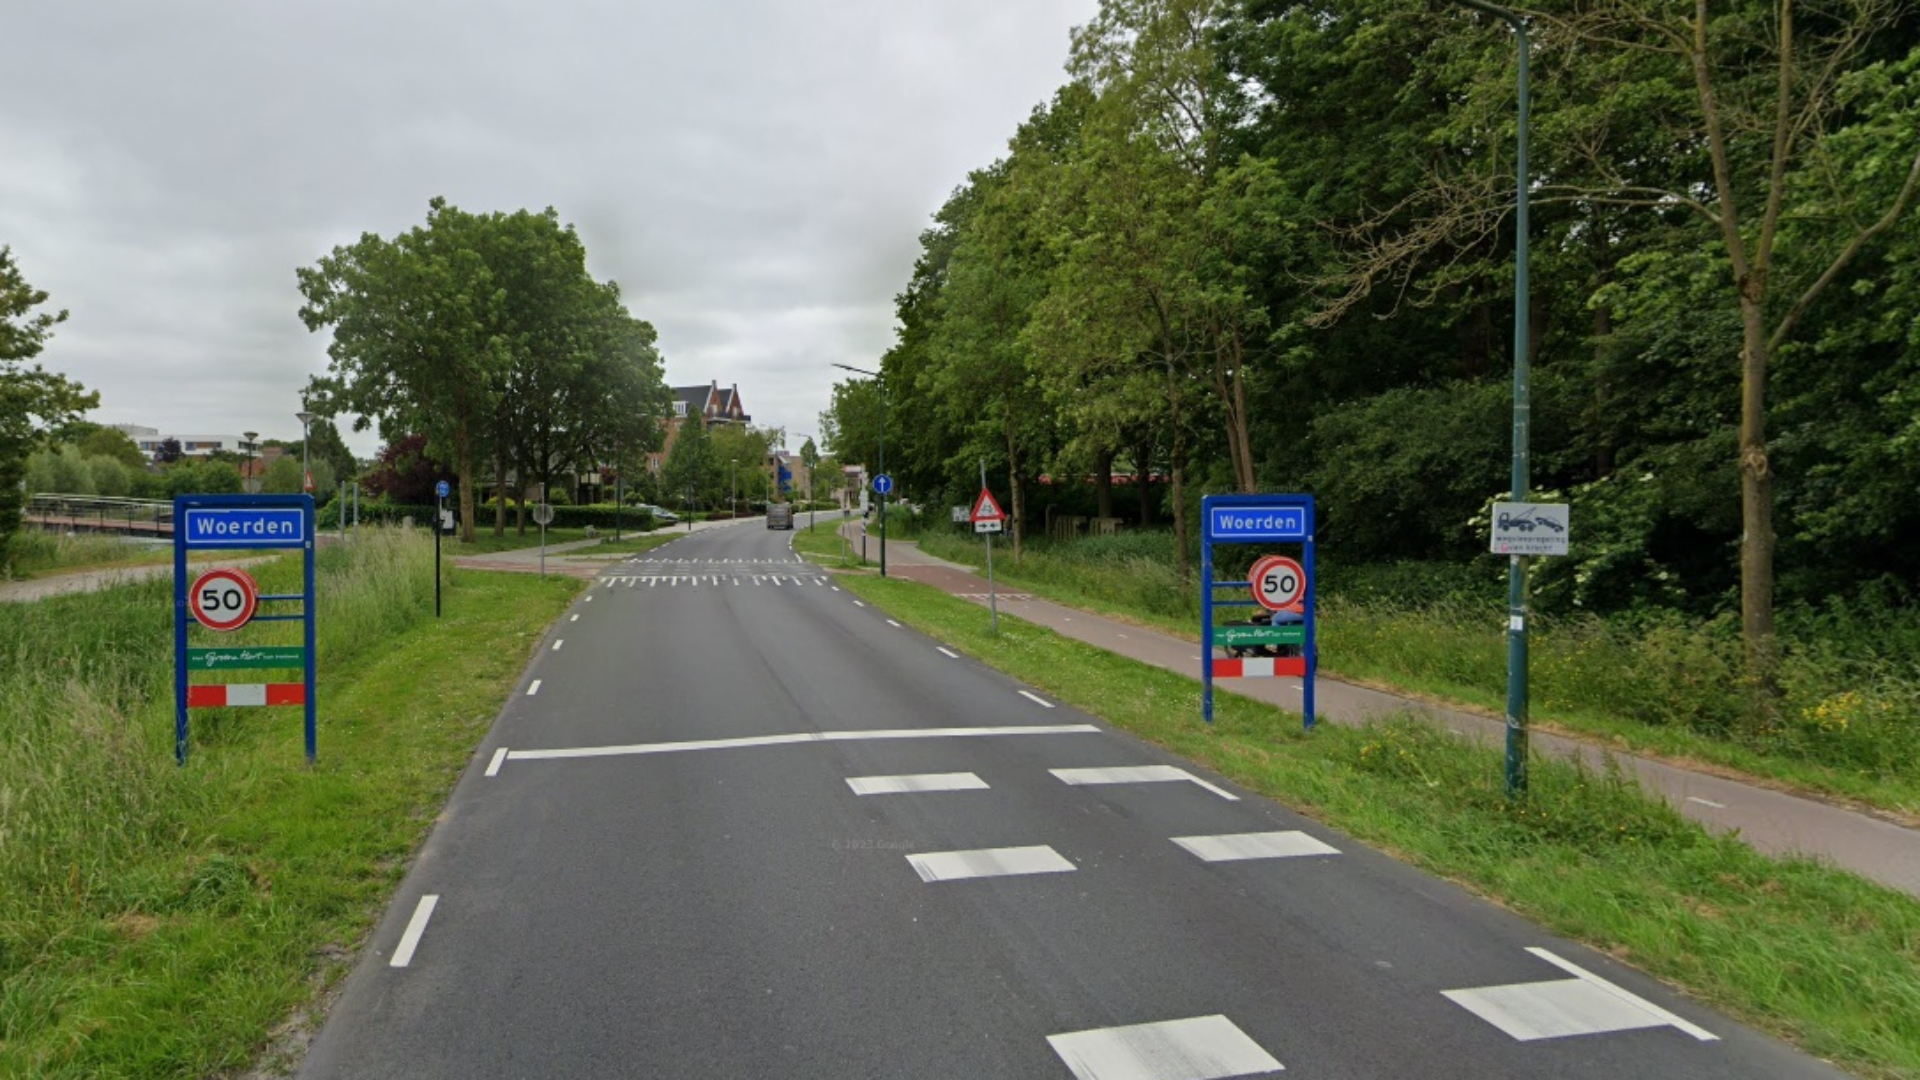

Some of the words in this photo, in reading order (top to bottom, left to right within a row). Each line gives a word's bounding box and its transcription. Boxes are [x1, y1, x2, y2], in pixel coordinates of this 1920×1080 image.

[197, 517, 293, 535] Woerden
[1220, 515, 1296, 530] Woerden
[1264, 575, 1295, 594] 50
[202, 589, 241, 611] 50
